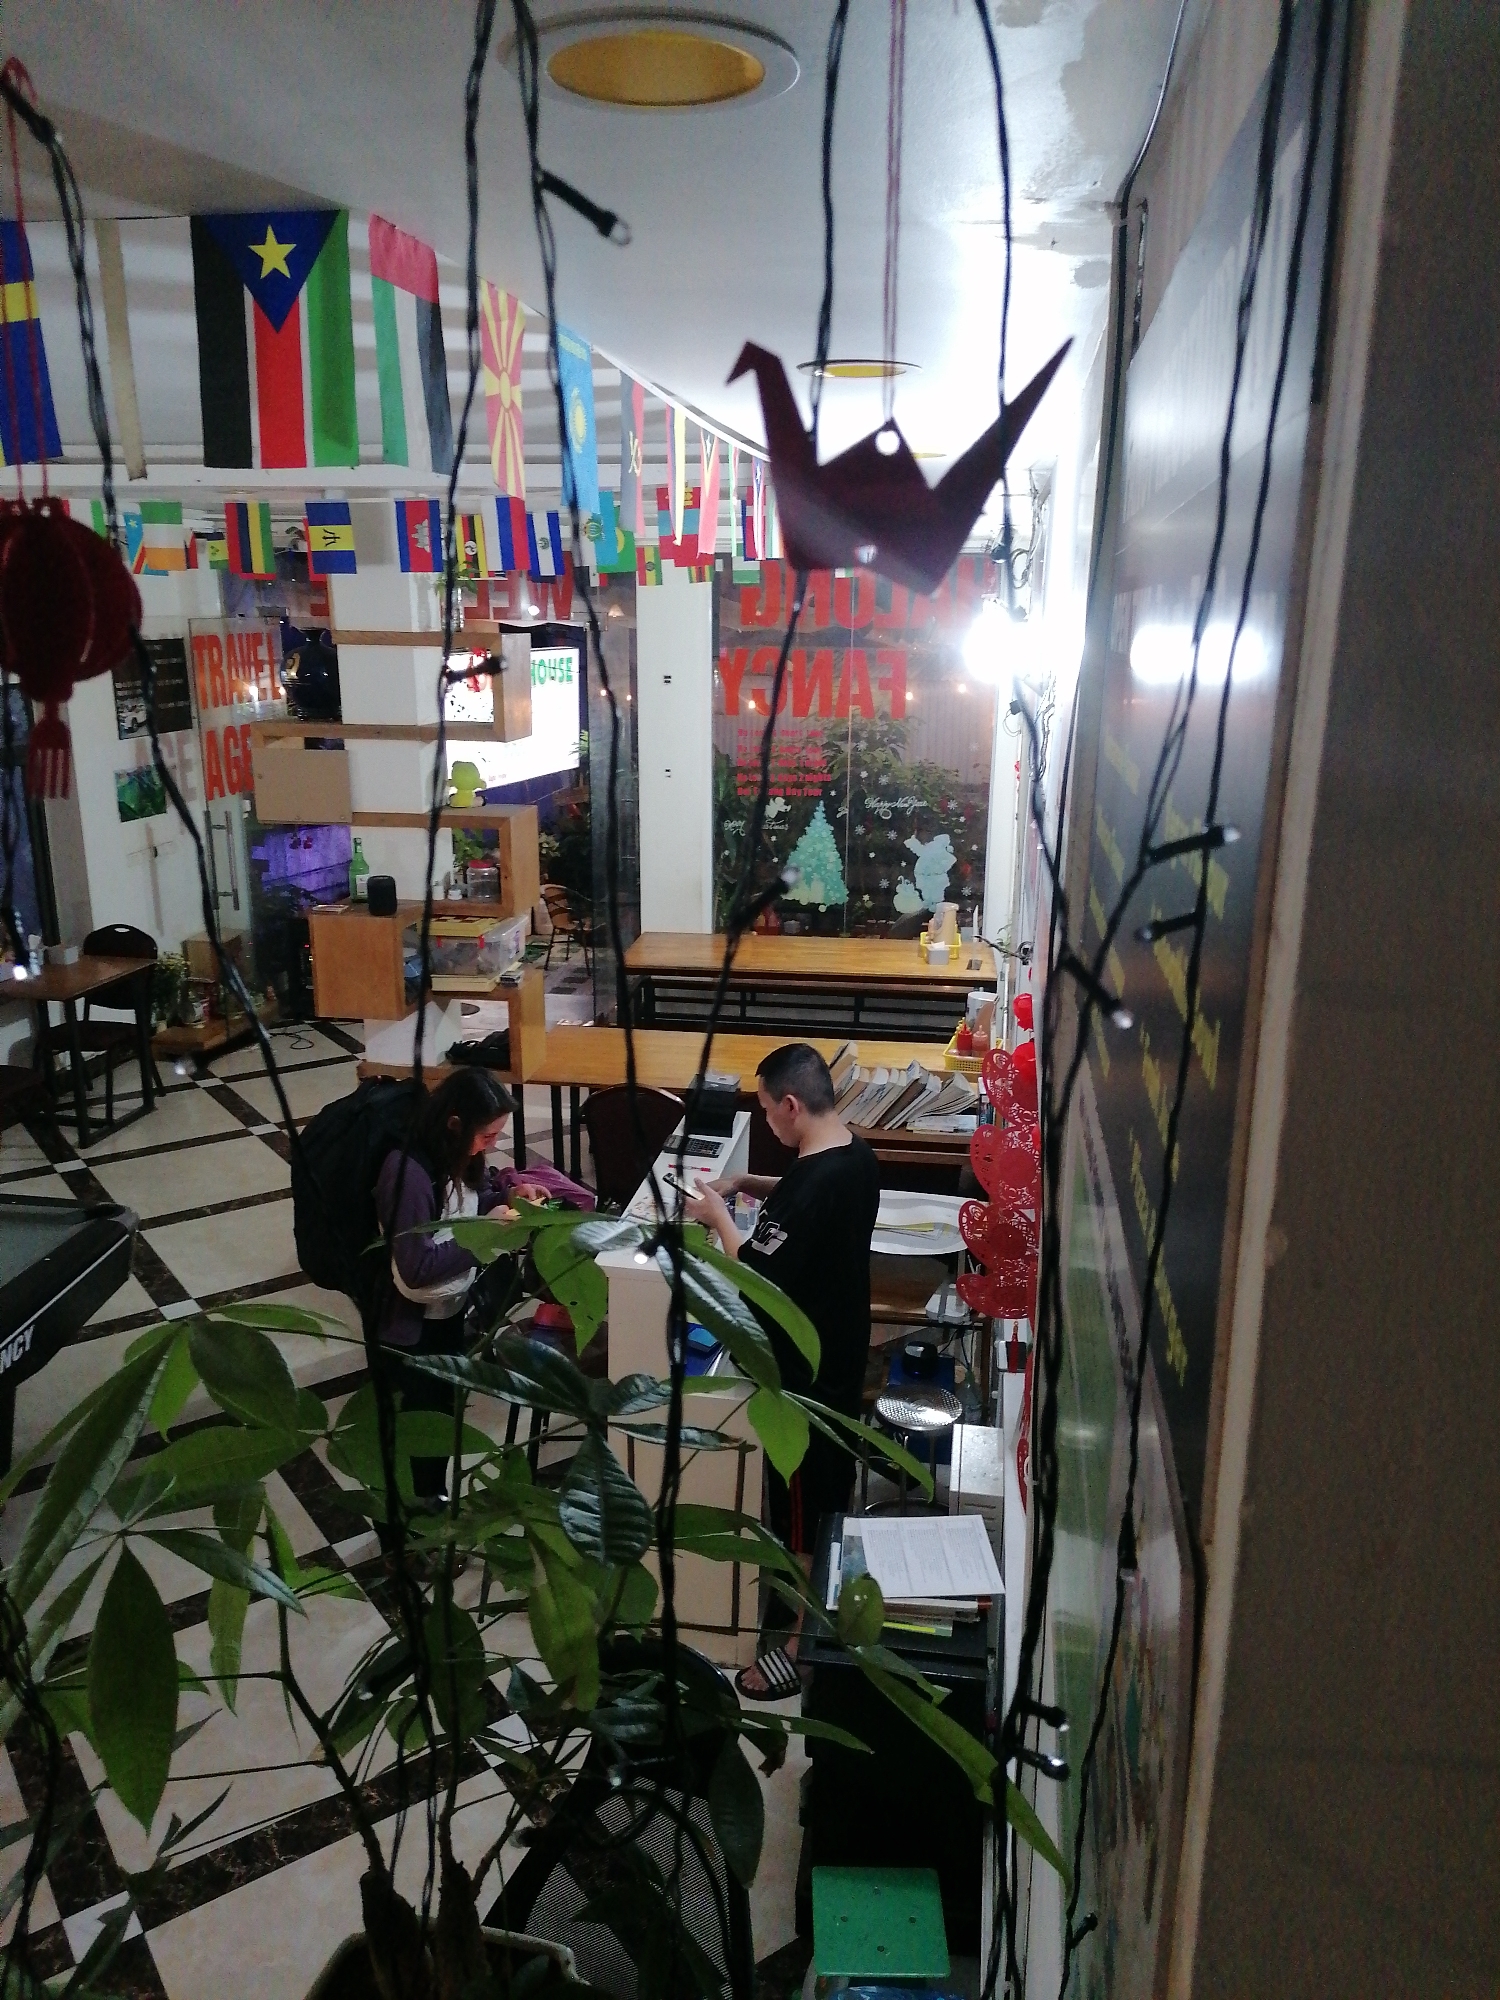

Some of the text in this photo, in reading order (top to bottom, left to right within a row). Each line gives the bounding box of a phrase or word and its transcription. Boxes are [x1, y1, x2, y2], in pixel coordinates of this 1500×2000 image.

[191, 632, 282, 710] TRAVEL
[864, 796, 929, 819] Happy New Year
